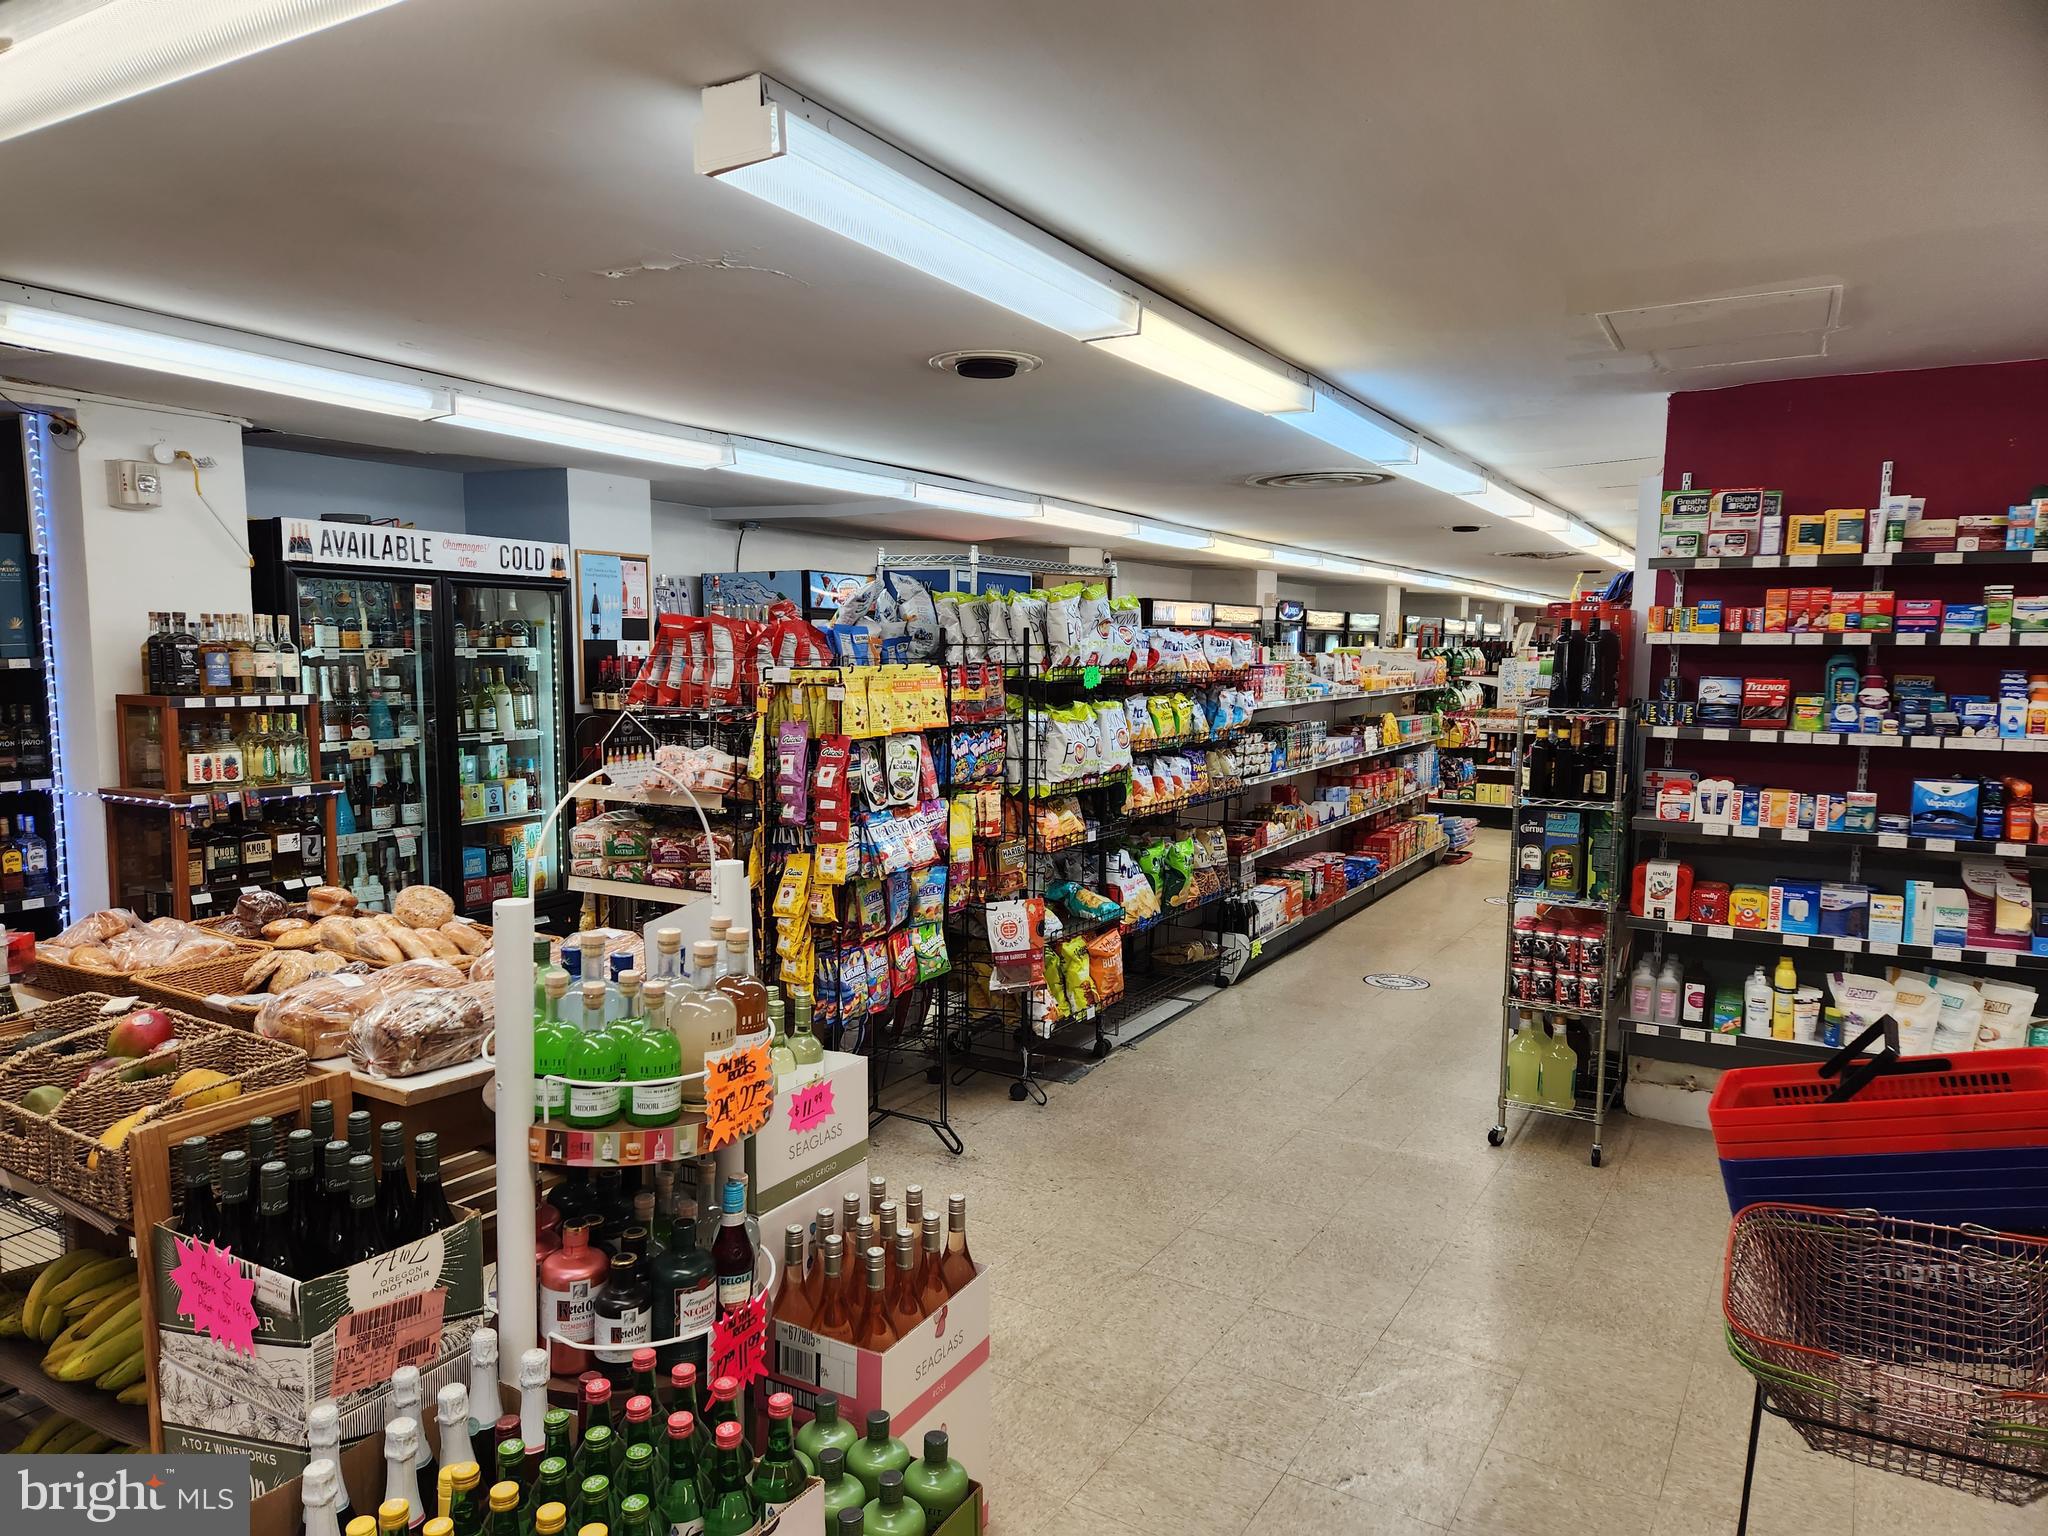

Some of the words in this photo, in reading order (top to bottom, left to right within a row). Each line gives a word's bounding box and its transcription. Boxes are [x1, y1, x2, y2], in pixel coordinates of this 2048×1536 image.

[1677, 497, 1707, 506] Breathe
[1726, 495, 1758, 504] Breathe
[1686, 504, 1708, 513] Right
[1735, 502, 1758, 512] Right
[320, 529, 433, 564] AVAILABLE
[500, 545, 544, 571] COLD
[1745, 682, 1787, 691] TYLENOL
[1925, 798, 1967, 808] VapoRub
[214, 847, 235, 857] KNOB
[247, 842, 266, 852] KNOB
[1002, 845, 1026, 858] HARIBO
[493, 855, 508, 863] LONG
[1551, 869, 1570, 878] MIX
[997, 935, 1024, 948] ISLAND
[717, 1060, 733, 1074] ON
[735, 1053, 749, 1065] THE
[727, 1061, 757, 1082] ROCKS
[574, 1104, 598, 1112] MIDORI
[635, 1102, 660, 1110] MIDORI
[788, 1122, 843, 1160] SEAGLASS
[795, 1173, 814, 1189] PINOT
[815, 1161, 837, 1178] GRIGIO
[372, 1249, 397, 1279] A
[408, 1239, 430, 1265] Z
[200, 1255, 207, 1271] A
[223, 1273, 233, 1290] Z
[380, 1265, 423, 1287] OREGON
[720, 1271, 751, 1286] DELOLA
[372, 1280, 404, 1300] PINOT
[406, 1270, 430, 1285] NOIR
[558, 1301, 586, 1320] Ketel
[610, 1328, 634, 1344] Ketel
[634, 1324, 648, 1335] One
[915, 1329, 964, 1381] SEAGLASS
[181, 1436, 188, 1448] A
[189, 1437, 202, 1451] TO
[204, 1441, 211, 1452] Z
